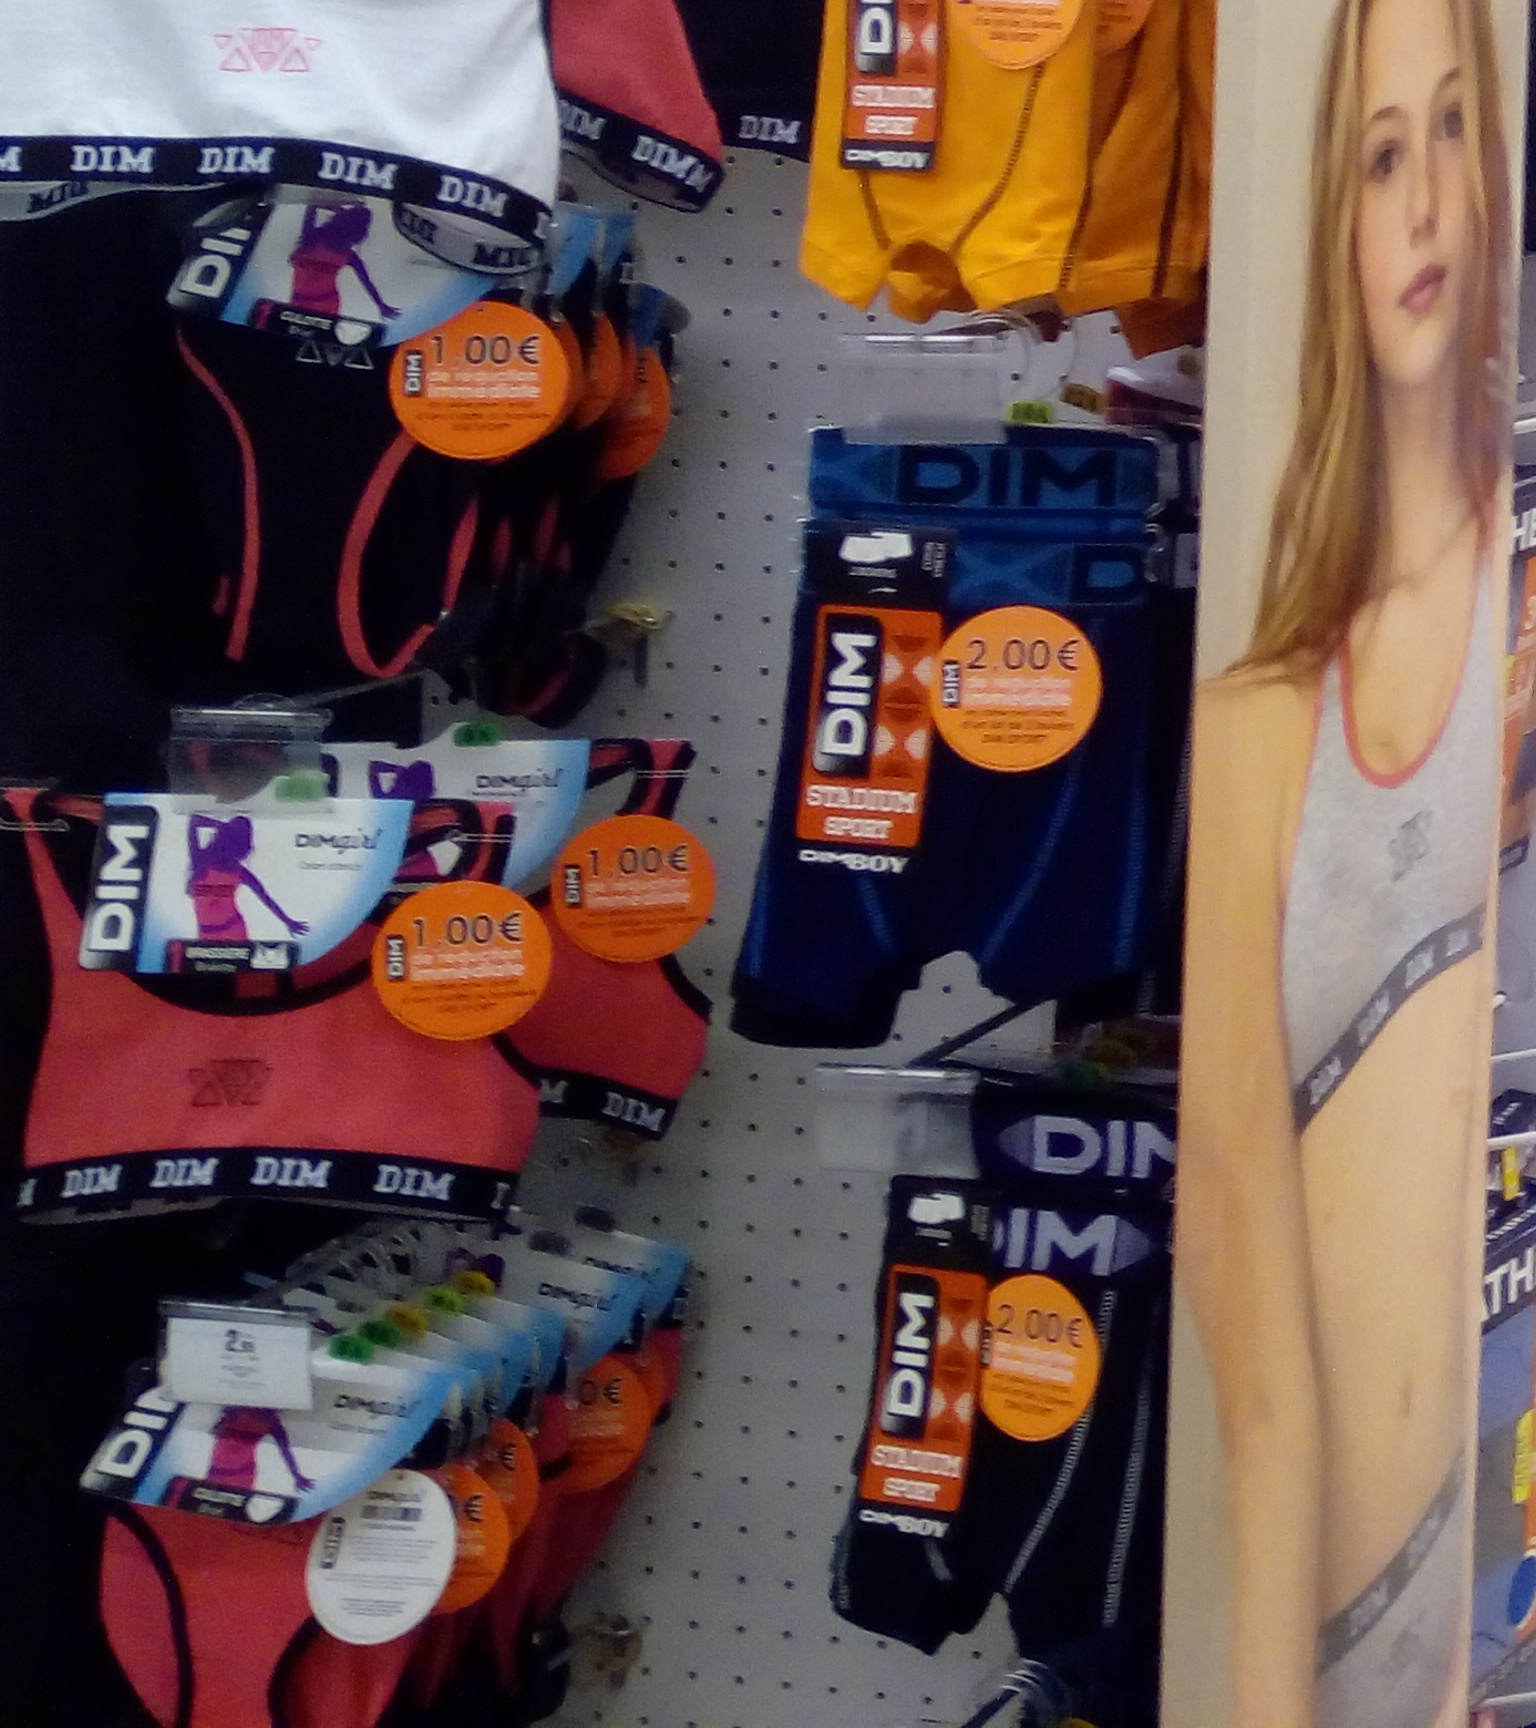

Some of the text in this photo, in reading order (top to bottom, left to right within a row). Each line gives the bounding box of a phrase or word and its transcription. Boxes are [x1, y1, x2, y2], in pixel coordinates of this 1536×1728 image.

[738, 115, 802, 144] DIM
[70, 145, 155, 173] DIM
[198, 146, 276, 174] DIM
[318, 151, 398, 191] DIM
[437, 174, 509, 217] DIM
[405, 352, 422, 393] DIM
[899, 445, 1117, 507] DIM
[966, 638, 1080, 671] 2.00€
[825, 633, 878, 758] DIM
[807, 784, 918, 814] STADIUM
[824, 815, 892, 839] SPORT
[799, 848, 909, 874] DIMBOY
[88, 824, 149, 952] DIM
[412, 911, 523, 947] 1.00€
[387, 936, 405, 981] DIM
[603, 1093, 665, 1134] DIM
[62, 1164, 123, 1199] DIM
[150, 1158, 220, 1189] DIM
[250, 1156, 332, 1188] DIM
[373, 1164, 455, 1201] DIM
[996, 1208, 1118, 1277] IM
[887, 1292, 934, 1419] DIM
[859, 1508, 948, 1539] DIMBOY
